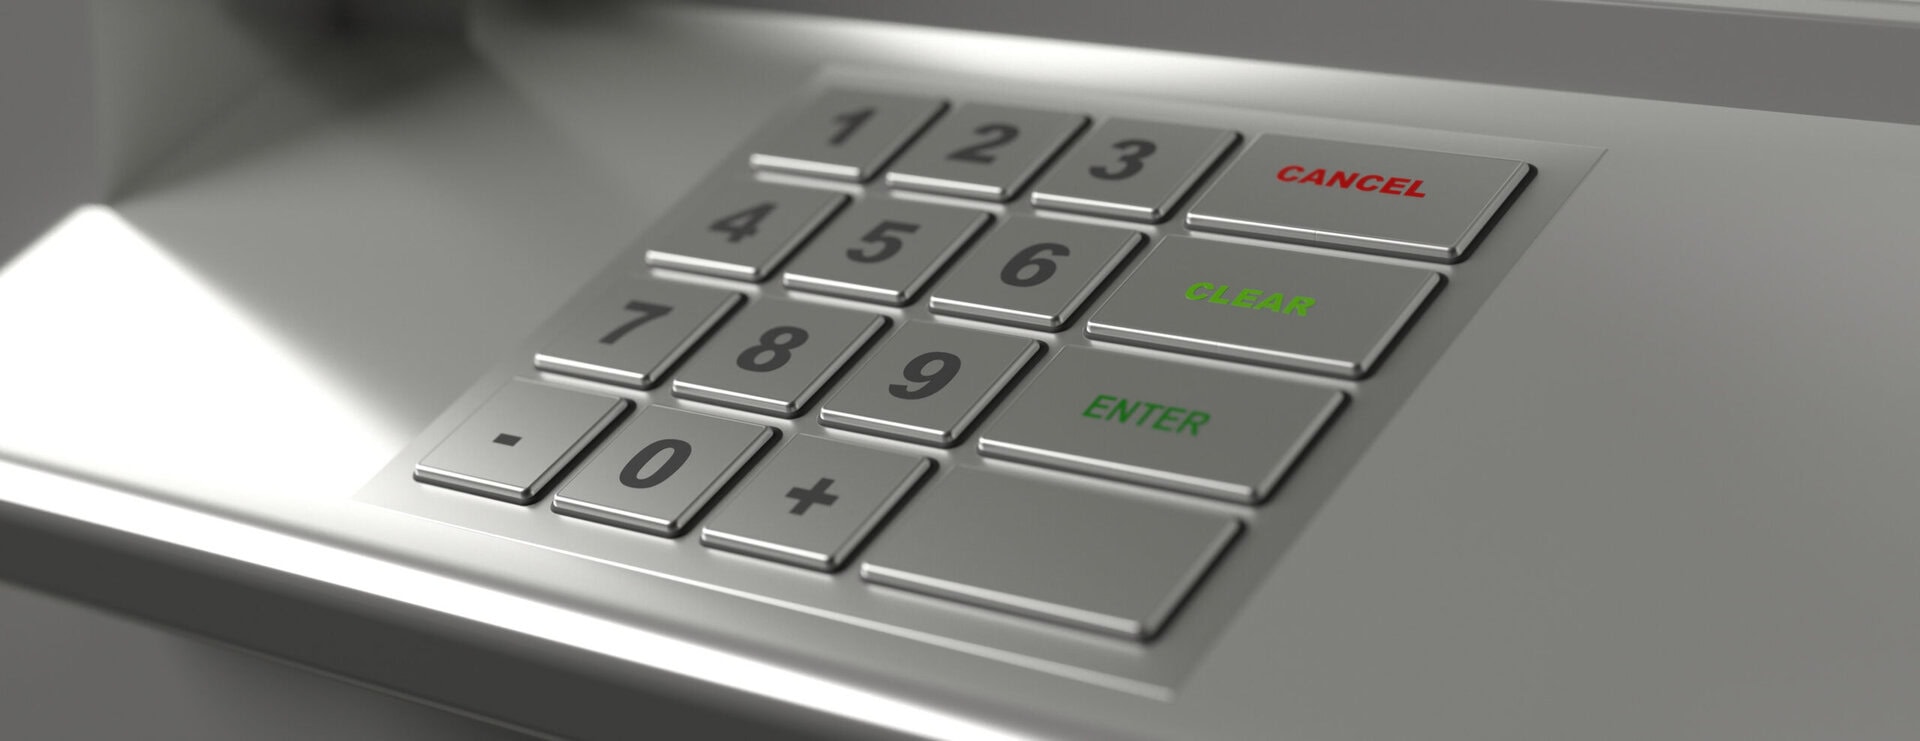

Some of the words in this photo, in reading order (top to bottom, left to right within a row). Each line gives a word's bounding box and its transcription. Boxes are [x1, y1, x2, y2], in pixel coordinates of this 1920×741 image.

[829, 107, 877, 147] 1
[947, 122, 1020, 165] 2
[1088, 137, 1158, 181] 3
[1276, 164, 1427, 199] CANCEL
[708, 201, 778, 244] 4
[846, 219, 921, 264] 5
[1000, 242, 1071, 288] 6
[1185, 281, 1318, 317] CLEAR
[599, 300, 673, 345] 7
[736, 325, 809, 373] 8
[888, 351, 962, 400] 9
[1083, 394, 1211, 436] ENTER
[619, 438, 692, 489] 0
